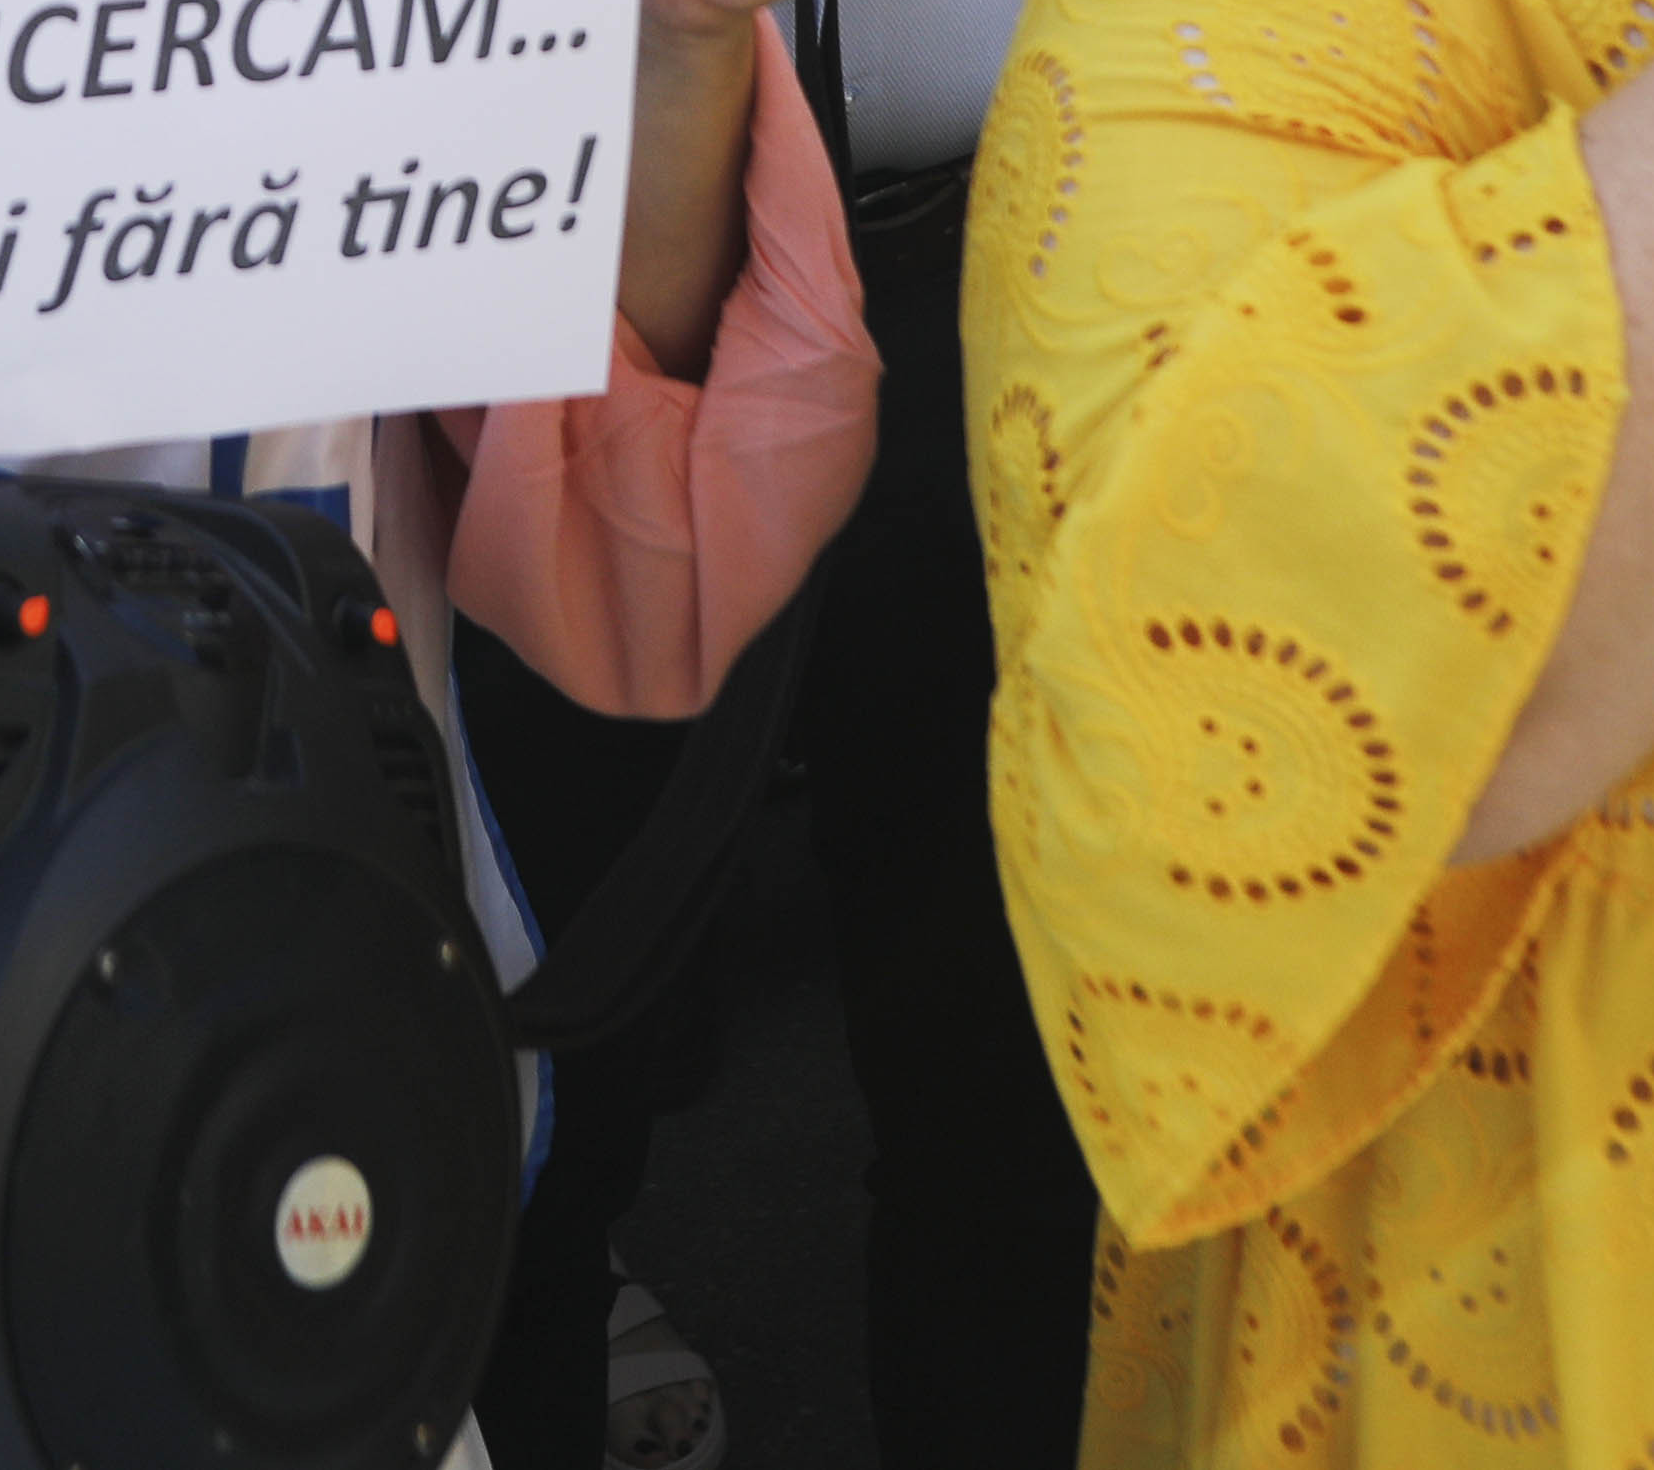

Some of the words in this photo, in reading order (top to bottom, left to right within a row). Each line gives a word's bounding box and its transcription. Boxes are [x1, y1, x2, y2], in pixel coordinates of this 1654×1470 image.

[37, 170, 299, 315] fără
[340, 135, 597, 259] tine!
[284, 1204, 365, 1244] AKAI
